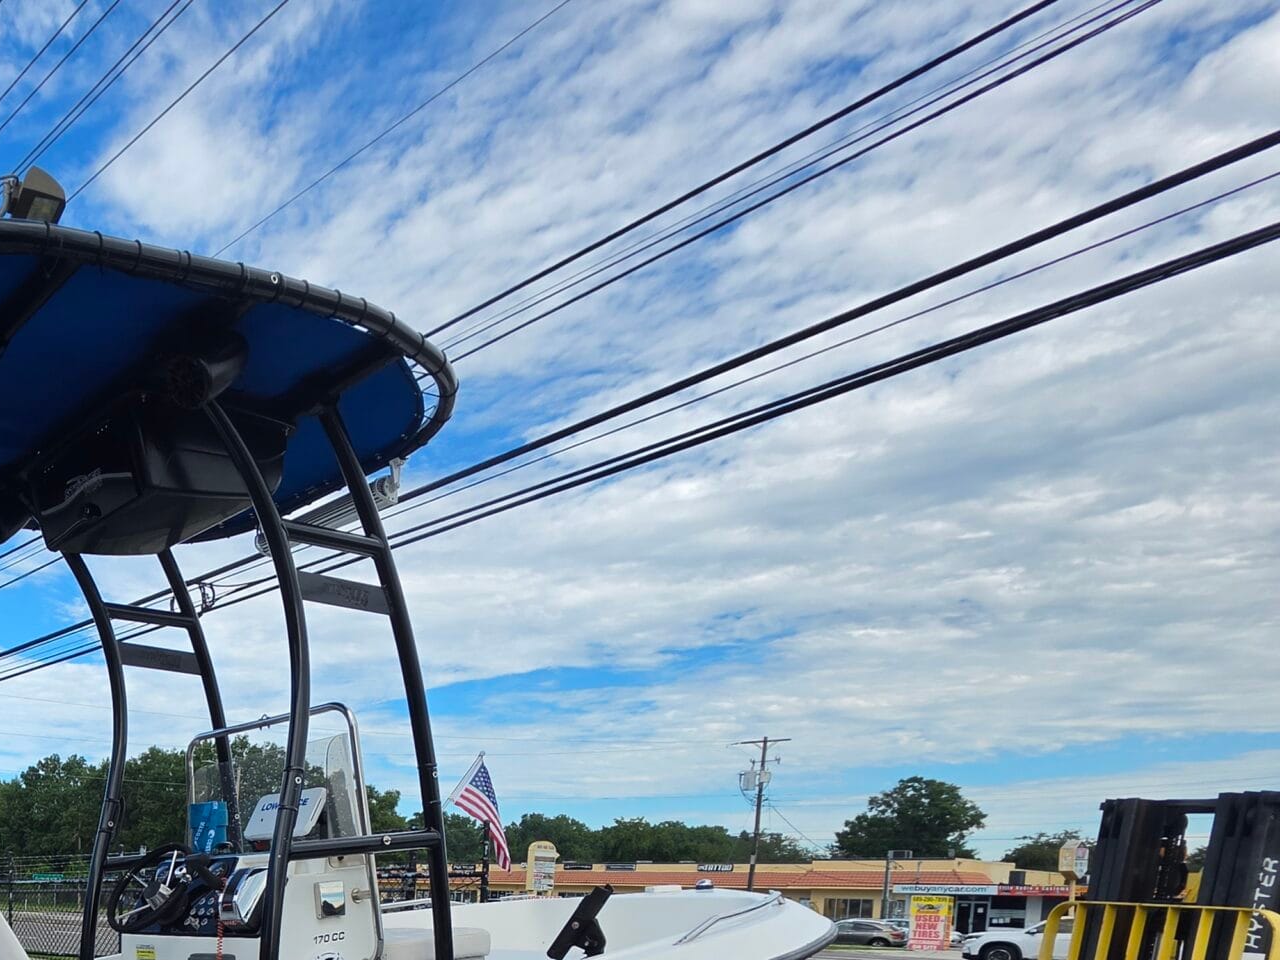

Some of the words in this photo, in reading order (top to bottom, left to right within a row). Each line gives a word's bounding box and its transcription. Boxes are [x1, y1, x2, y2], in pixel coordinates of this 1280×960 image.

[915, 914, 940, 922] USED
[915, 922, 938, 930] NEW
[313, 934, 330, 945] 170
[332, 931, 345, 942] CC
[912, 930, 940, 938] TIRES
